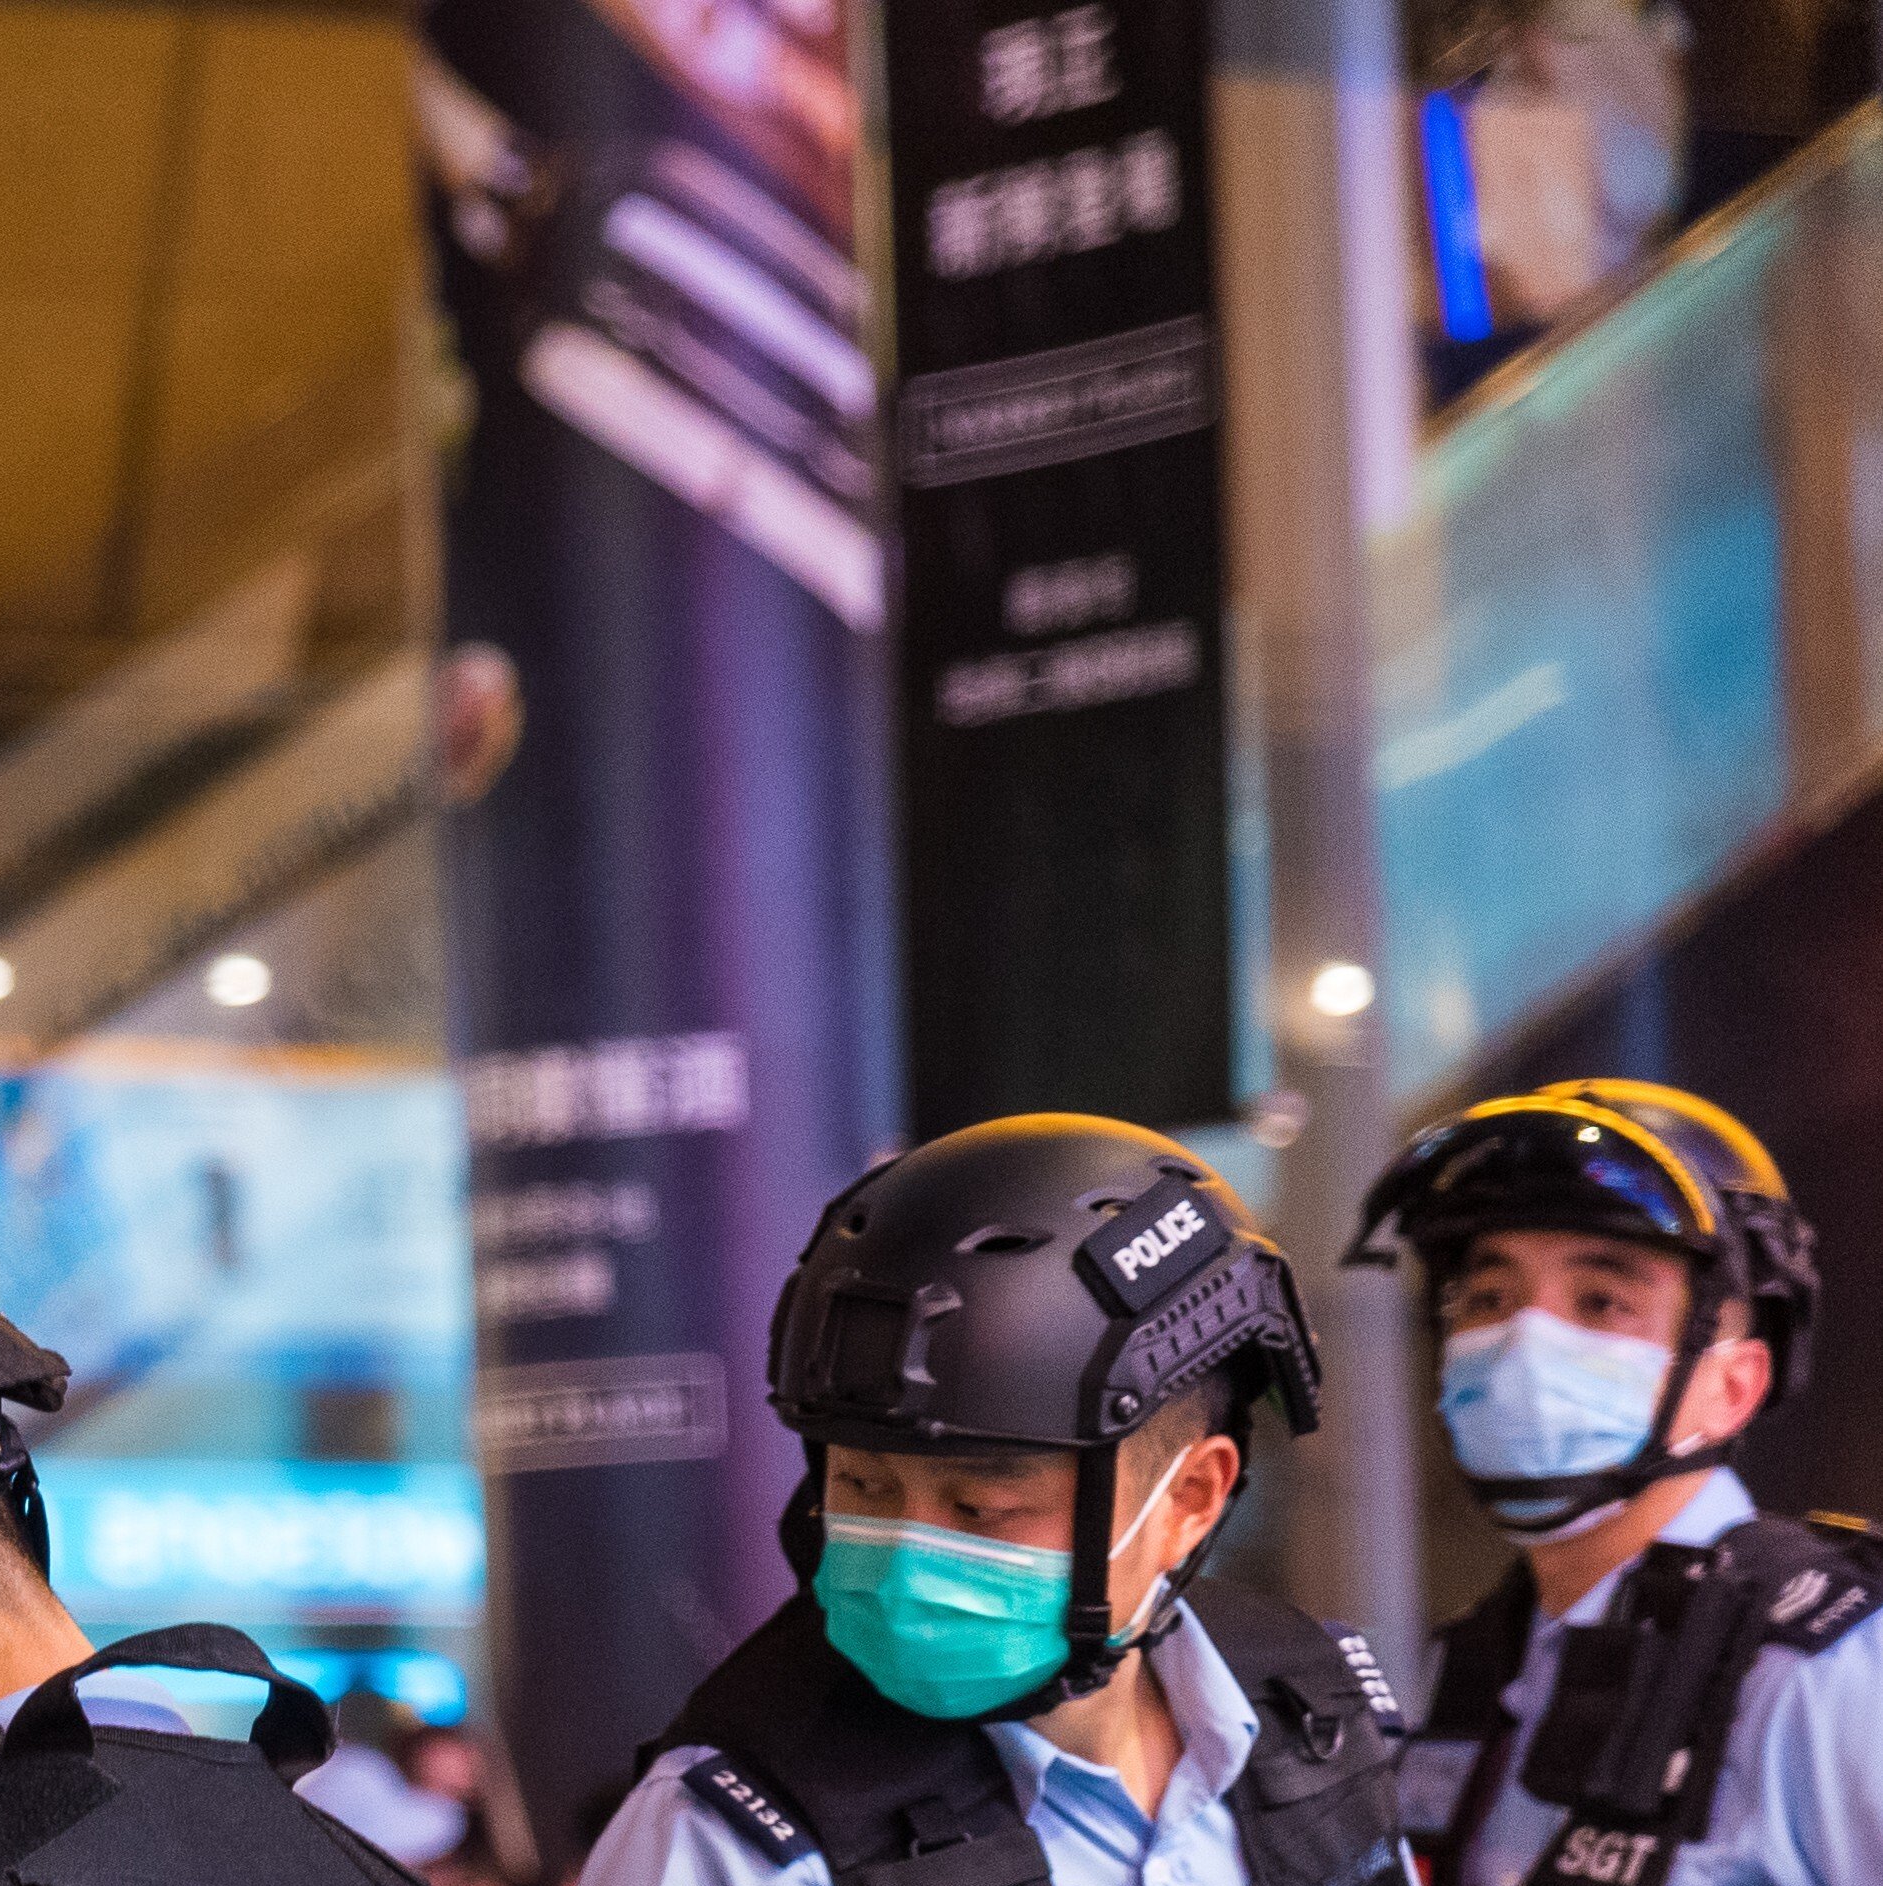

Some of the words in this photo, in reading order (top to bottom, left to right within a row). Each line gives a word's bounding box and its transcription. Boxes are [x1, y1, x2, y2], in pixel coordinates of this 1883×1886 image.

[1112, 1199, 1206, 1281] POLICE
[712, 1769, 795, 1841] 22132
[1556, 1826, 1659, 1886] SGT
